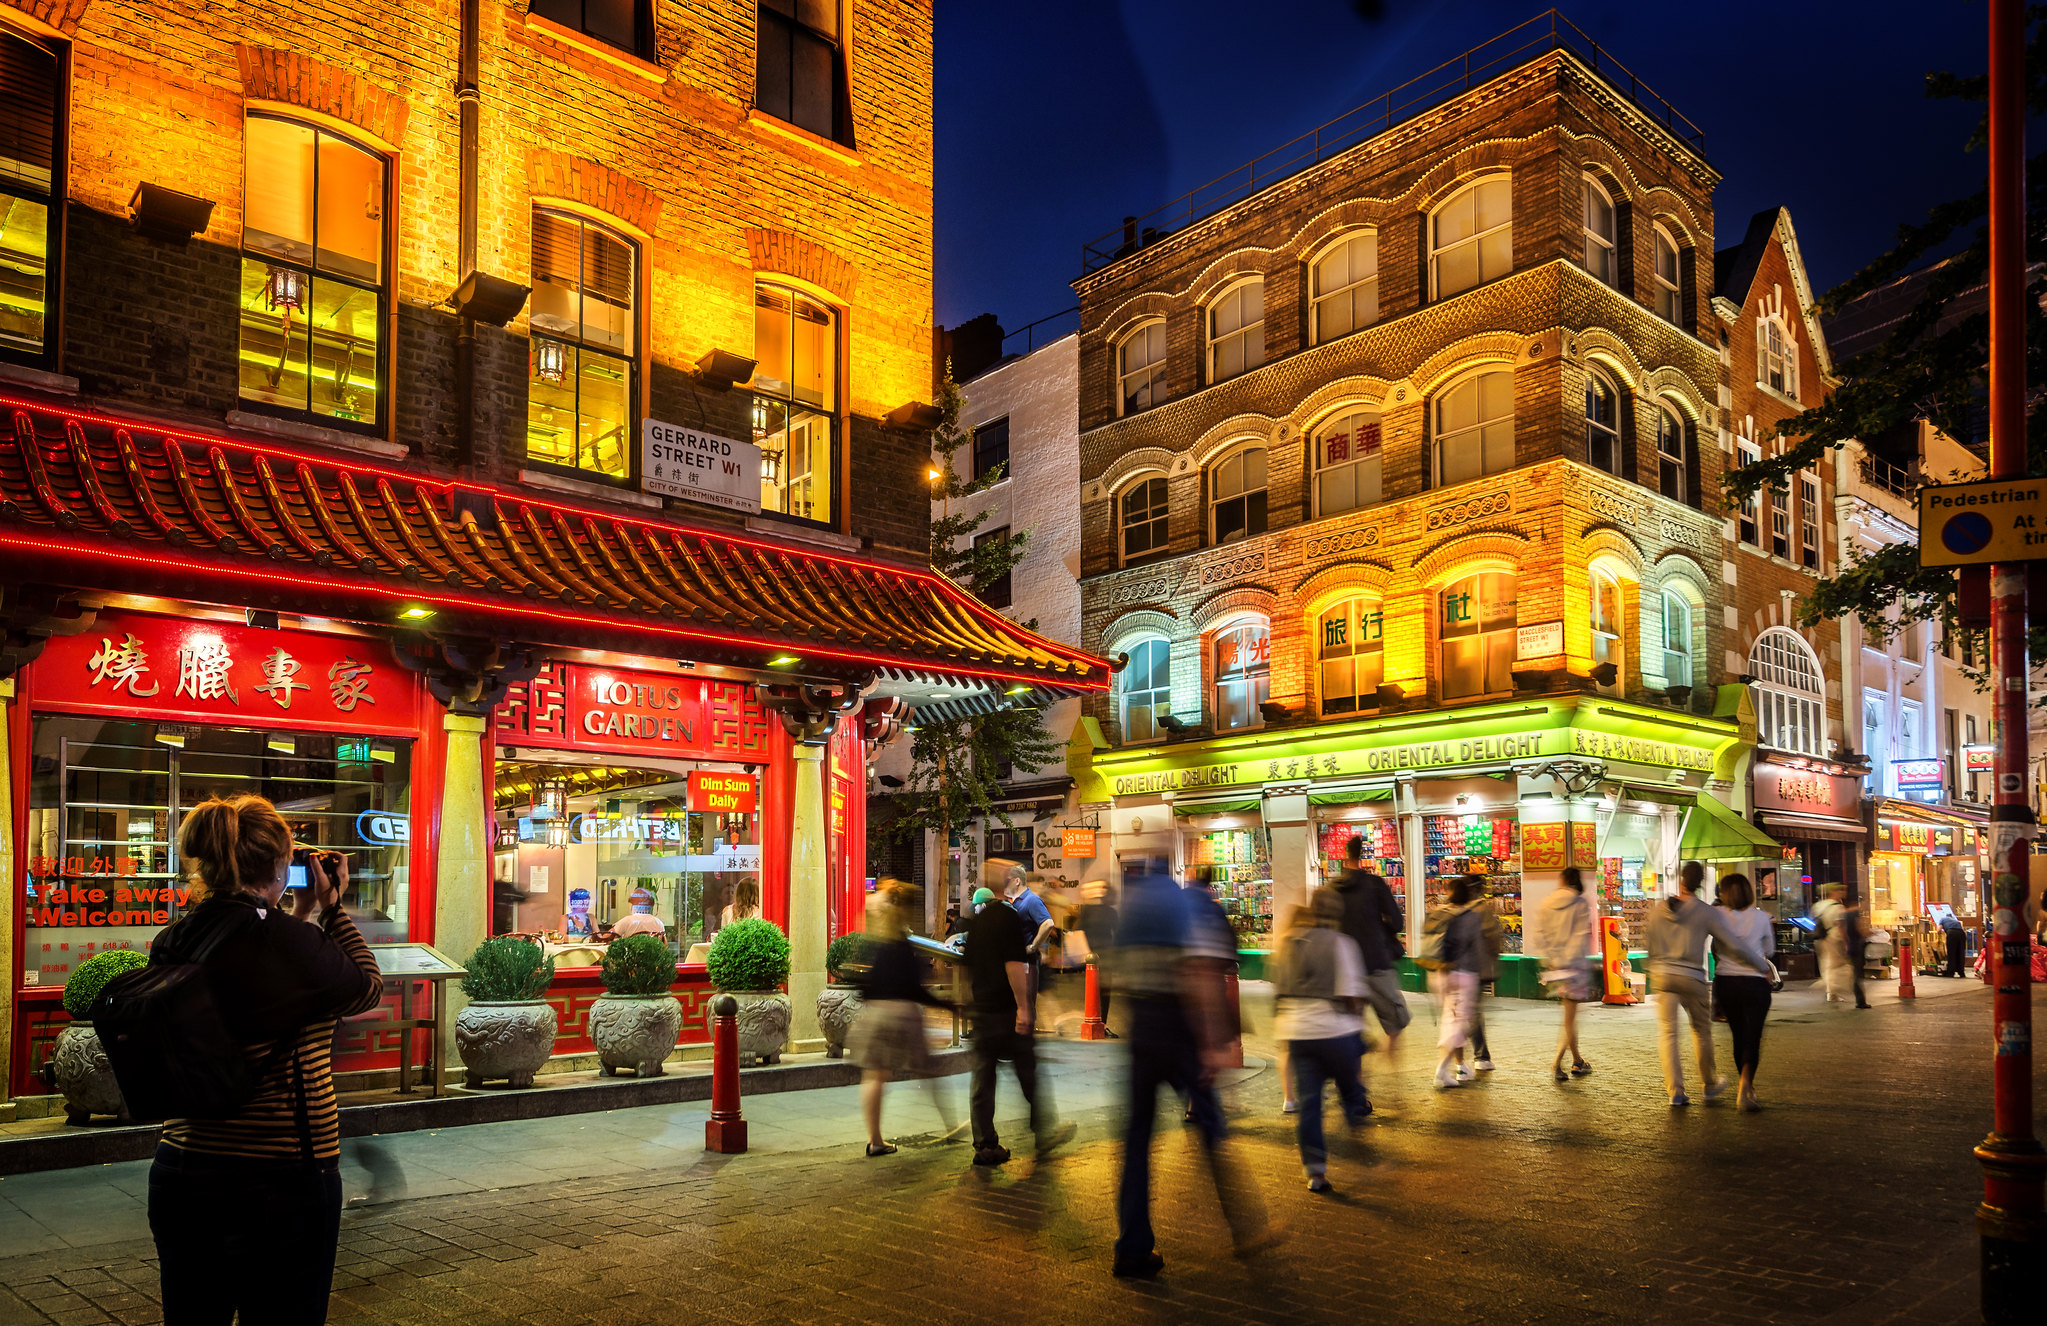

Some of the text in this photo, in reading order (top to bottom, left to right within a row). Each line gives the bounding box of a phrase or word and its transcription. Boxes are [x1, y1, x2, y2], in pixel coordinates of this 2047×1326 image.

[651, 426, 731, 456] GERRARD
[652, 444, 741, 477] STREET W1
[649, 481, 667, 491] CITY
[668, 485, 679, 493] OF
[680, 487, 734, 505] WESTMINSTER
[1931, 489, 2038, 508] Pedestrian
[2013, 515, 2035, 529] At
[1446, 592, 1471, 623] 社
[1325, 611, 1383, 646] 旅行
[1520, 624, 1559, 636] MACCLESFIELD
[1520, 635, 1538, 644] STREET
[88, 632, 375, 711] 燒臘專家
[596, 676, 681, 711] LOTUS
[584, 710, 693, 743] GARDEN
[1368, 732, 1542, 769] ORIENTAL DELIGHT
[1626, 739, 1713, 770] ORIENTAL DELIGHT
[1267, 753, 1340, 780] 東方美味
[700, 777, 750, 792] Dim Sum
[1116, 765, 1238, 794] ORIENTAL DELIGHT
[709, 794, 738, 810] Daily
[1036, 832, 1062, 848] GOLD
[1036, 853, 1062, 869] GATE
[1059, 875, 1079, 889] SHOP
[32, 884, 192, 907] Take away
[32, 907, 169, 926] Welcome
